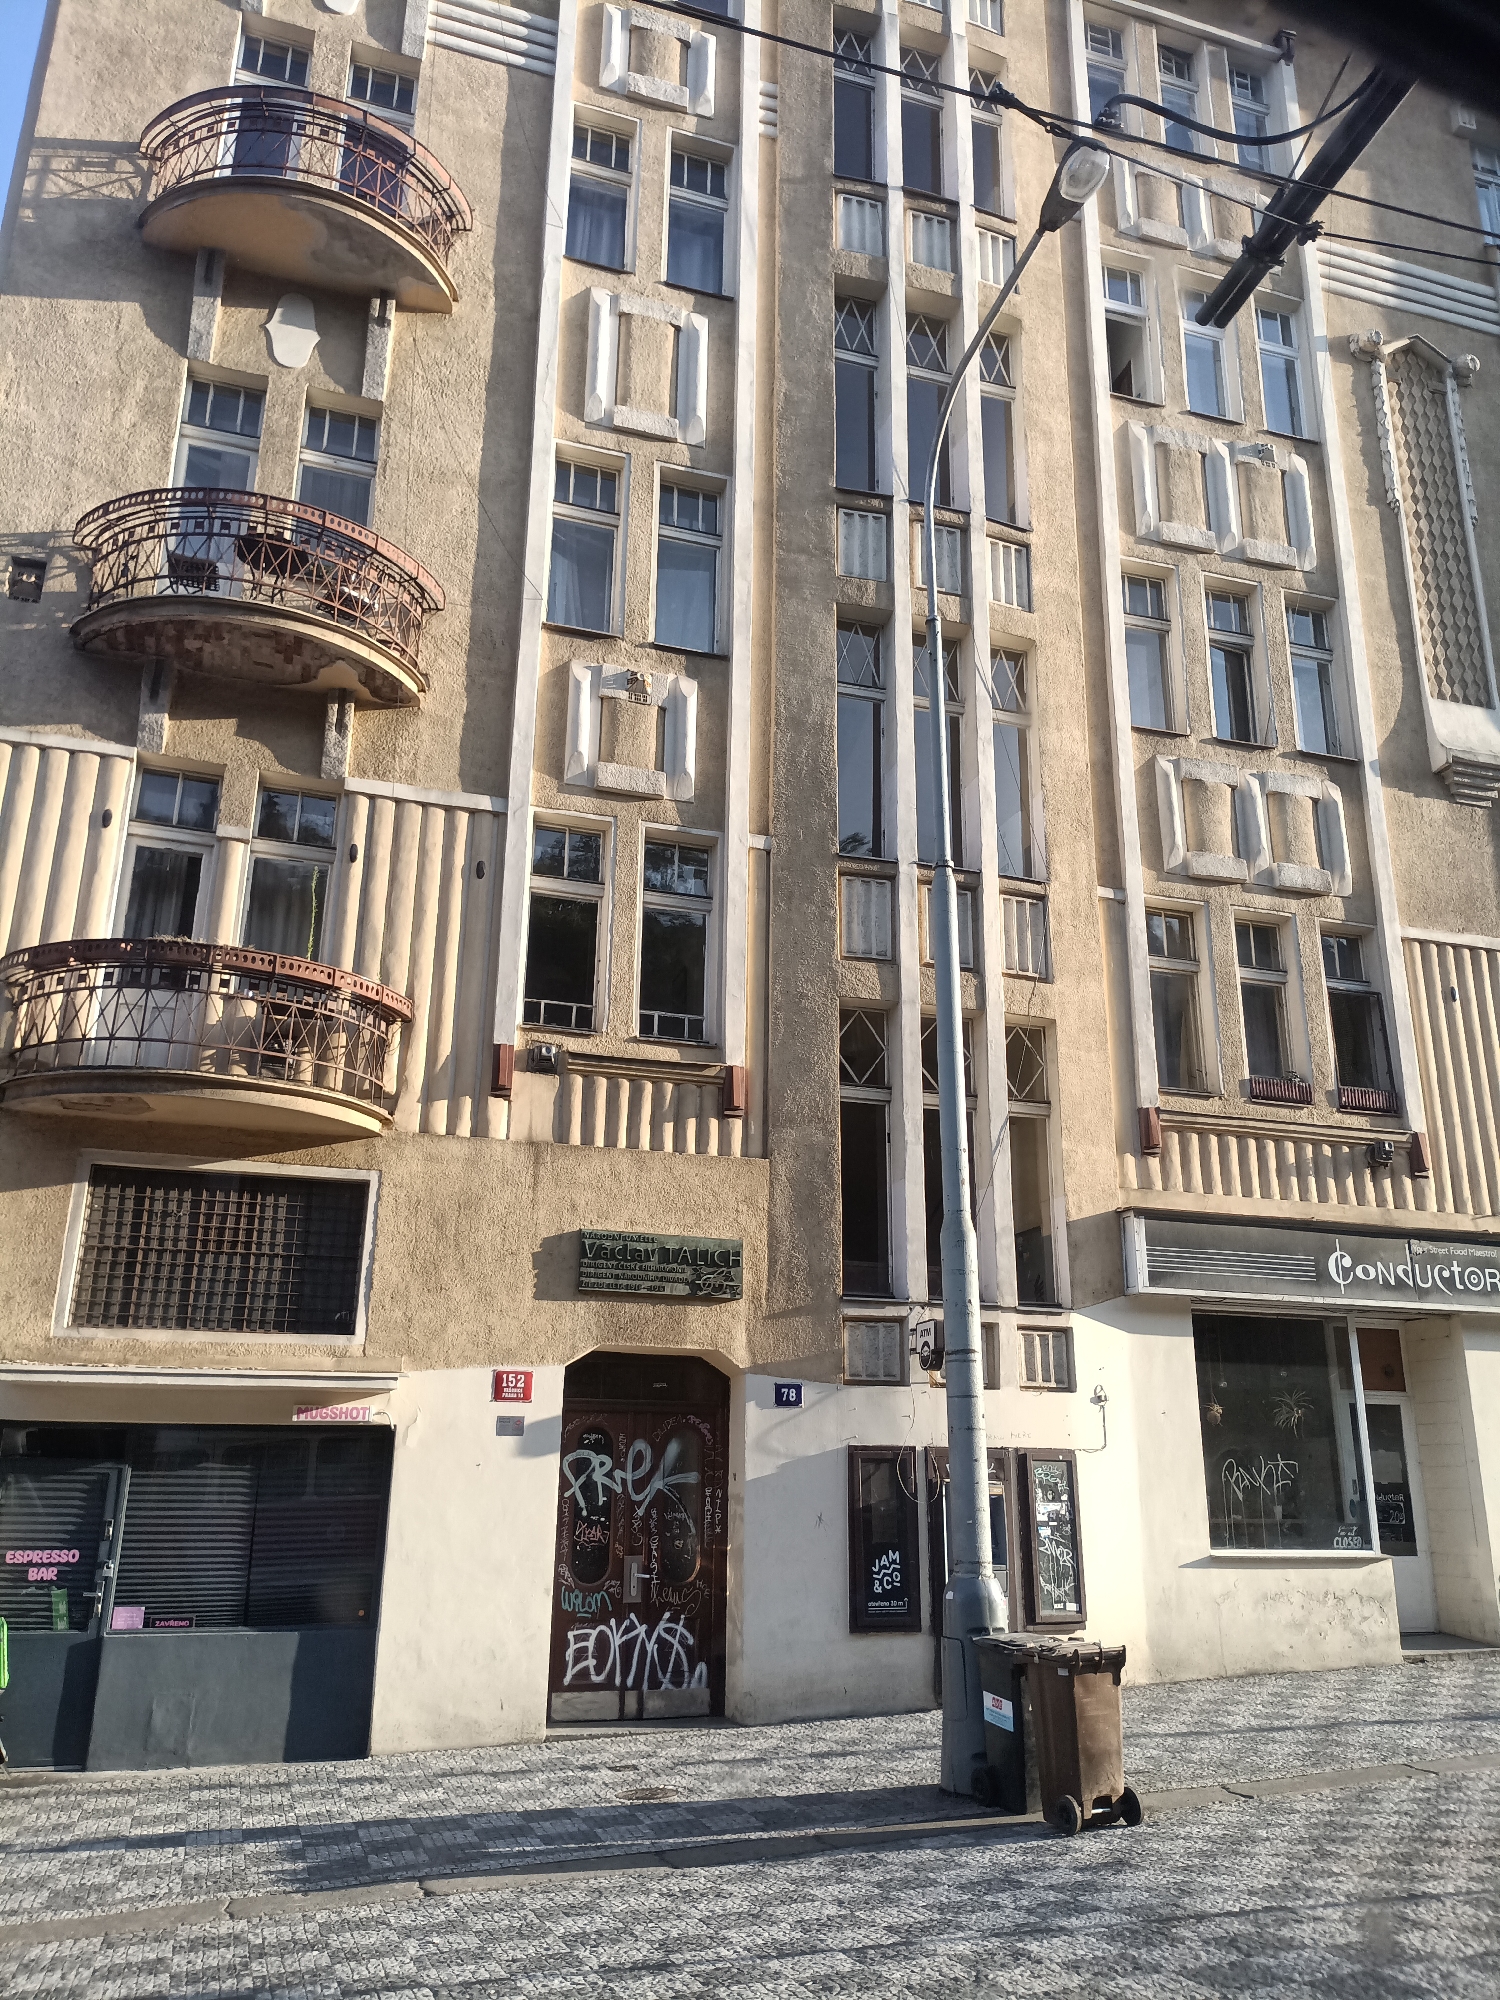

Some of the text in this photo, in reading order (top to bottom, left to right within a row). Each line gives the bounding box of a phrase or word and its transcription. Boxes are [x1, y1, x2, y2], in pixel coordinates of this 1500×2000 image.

[665, 1245, 742, 1267] TALICH
[1429, 1246, 1449, 1255] Street
[1450, 1246, 1468, 1256] Food
[919, 1327, 932, 1339] ATM
[502, 1373, 525, 1388] 152
[780, 1388, 797, 1402] 78
[296, 1406, 369, 1421] MUGSHOT
[1333, 1536, 1363, 1549] CLOSED
[5, 1549, 80, 1564] ESPRESSO
[872, 1549, 900, 1572] JAM
[27, 1567, 58, 1581] BAR
[154, 1619, 190, 1627] ZAVŘENO
